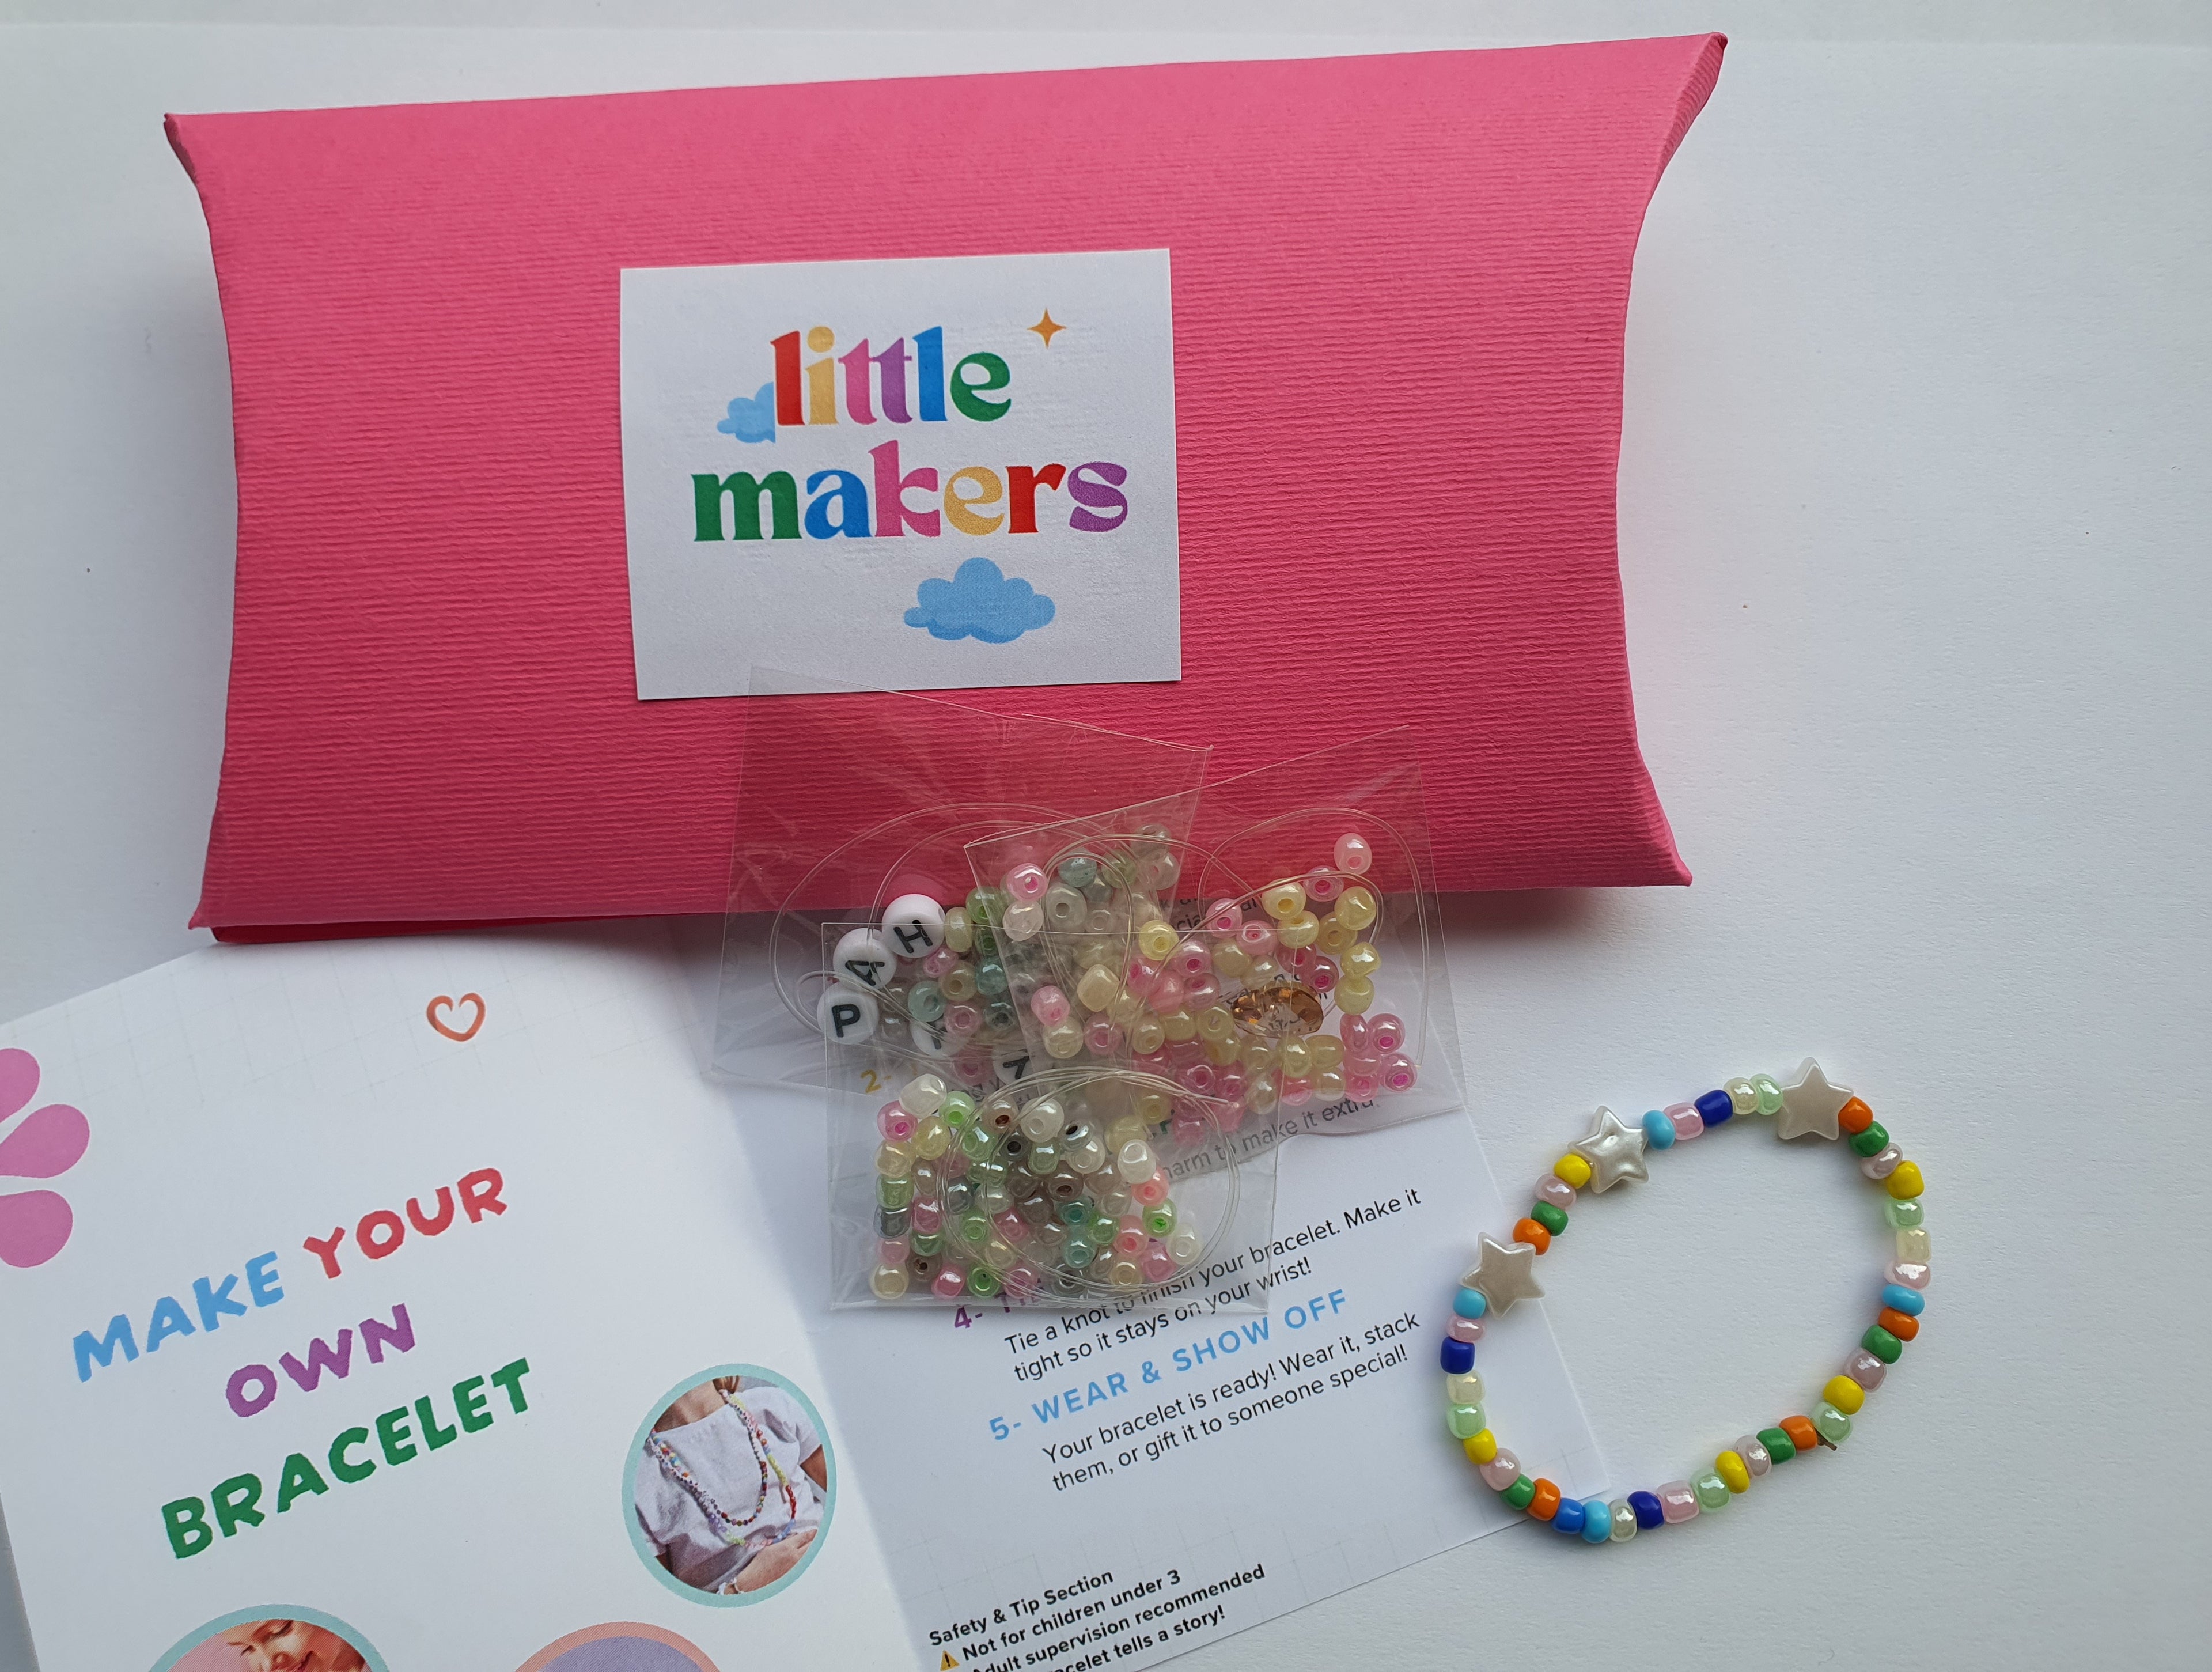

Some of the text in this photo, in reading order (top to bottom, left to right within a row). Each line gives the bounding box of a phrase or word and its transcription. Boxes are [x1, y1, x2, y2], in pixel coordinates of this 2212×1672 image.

[770, 326, 1011, 426] little
[691, 440, 1128, 542] makers
[1243, 1119, 1298, 1152] make
[1302, 1111, 1318, 1129] it
[72, 1167, 507, 1382] MAKE YOUR
[1004, 1333, 1039, 1353] Tie
[1046, 1326, 1058, 1340] a
[1199, 1254, 1244, 1288] your
[1249, 1220, 1340, 1264] bracelet.
[1344, 1198, 1401, 1229] Make
[1404, 1189, 1421, 1206] it
[1014, 1256, 1312, 1381] tight so it stays on your wrist!
[225, 1303, 415, 1417] OWN
[988, 1288, 1346, 1440] 5- WEAR & SHOW OFF
[1041, 1312, 1421, 1465] Your bracelet is ready! Wear it, stack
[1052, 1343, 1408, 1491] them, or gift it to someone special!
[161, 1357, 529, 1559] BRACELET
[929, 1571, 1113, 1646] Safety & Tip Section
[962, 1569, 1181, 1661] Not for children under 3
[972, 1563, 1266, 1672] dult supervision recommended
[1113, 1635, 1153, 1658] tells
[1158, 1629, 1169, 1642] a
[1173, 1604, 1226, 1636] story!
